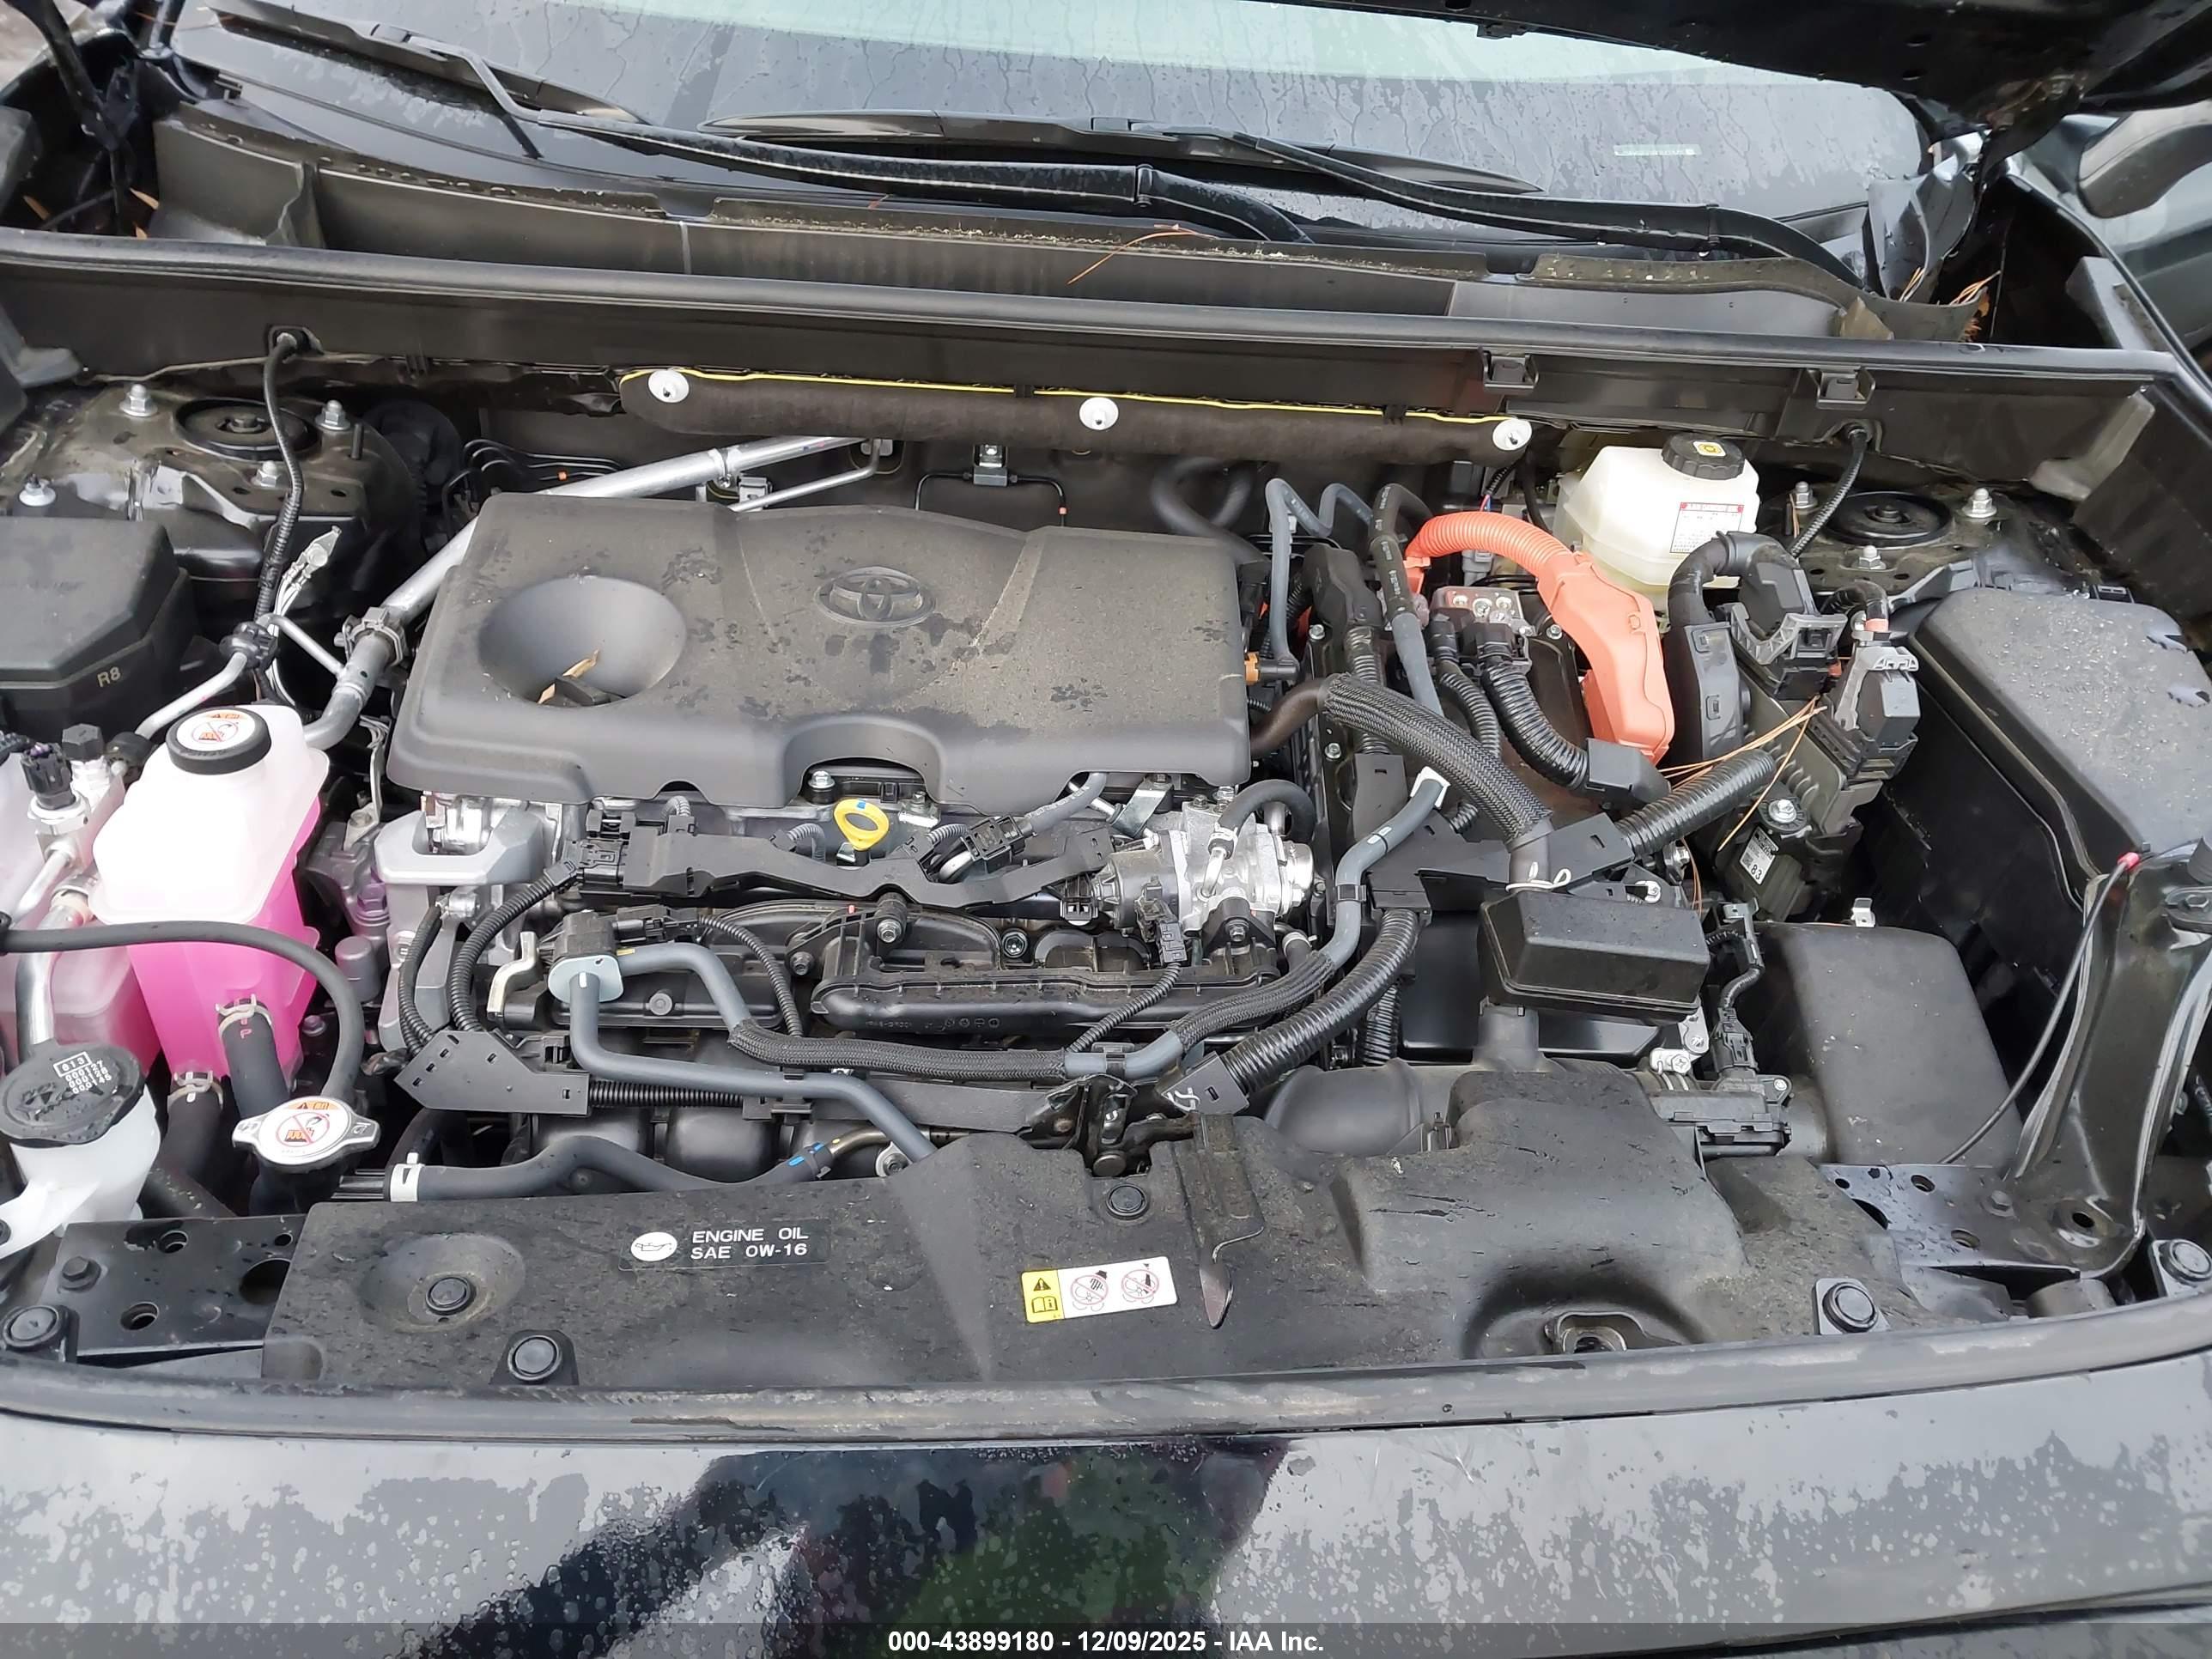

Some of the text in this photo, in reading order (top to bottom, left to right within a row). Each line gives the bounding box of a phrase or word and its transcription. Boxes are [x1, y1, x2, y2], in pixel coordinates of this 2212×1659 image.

[97, 666, 121, 688] R8
[1750, 863, 1763, 880] 83
[692, 1227, 809, 1243] ENGINE OIL
[690, 1243, 808, 1260] SAE 0W-16
